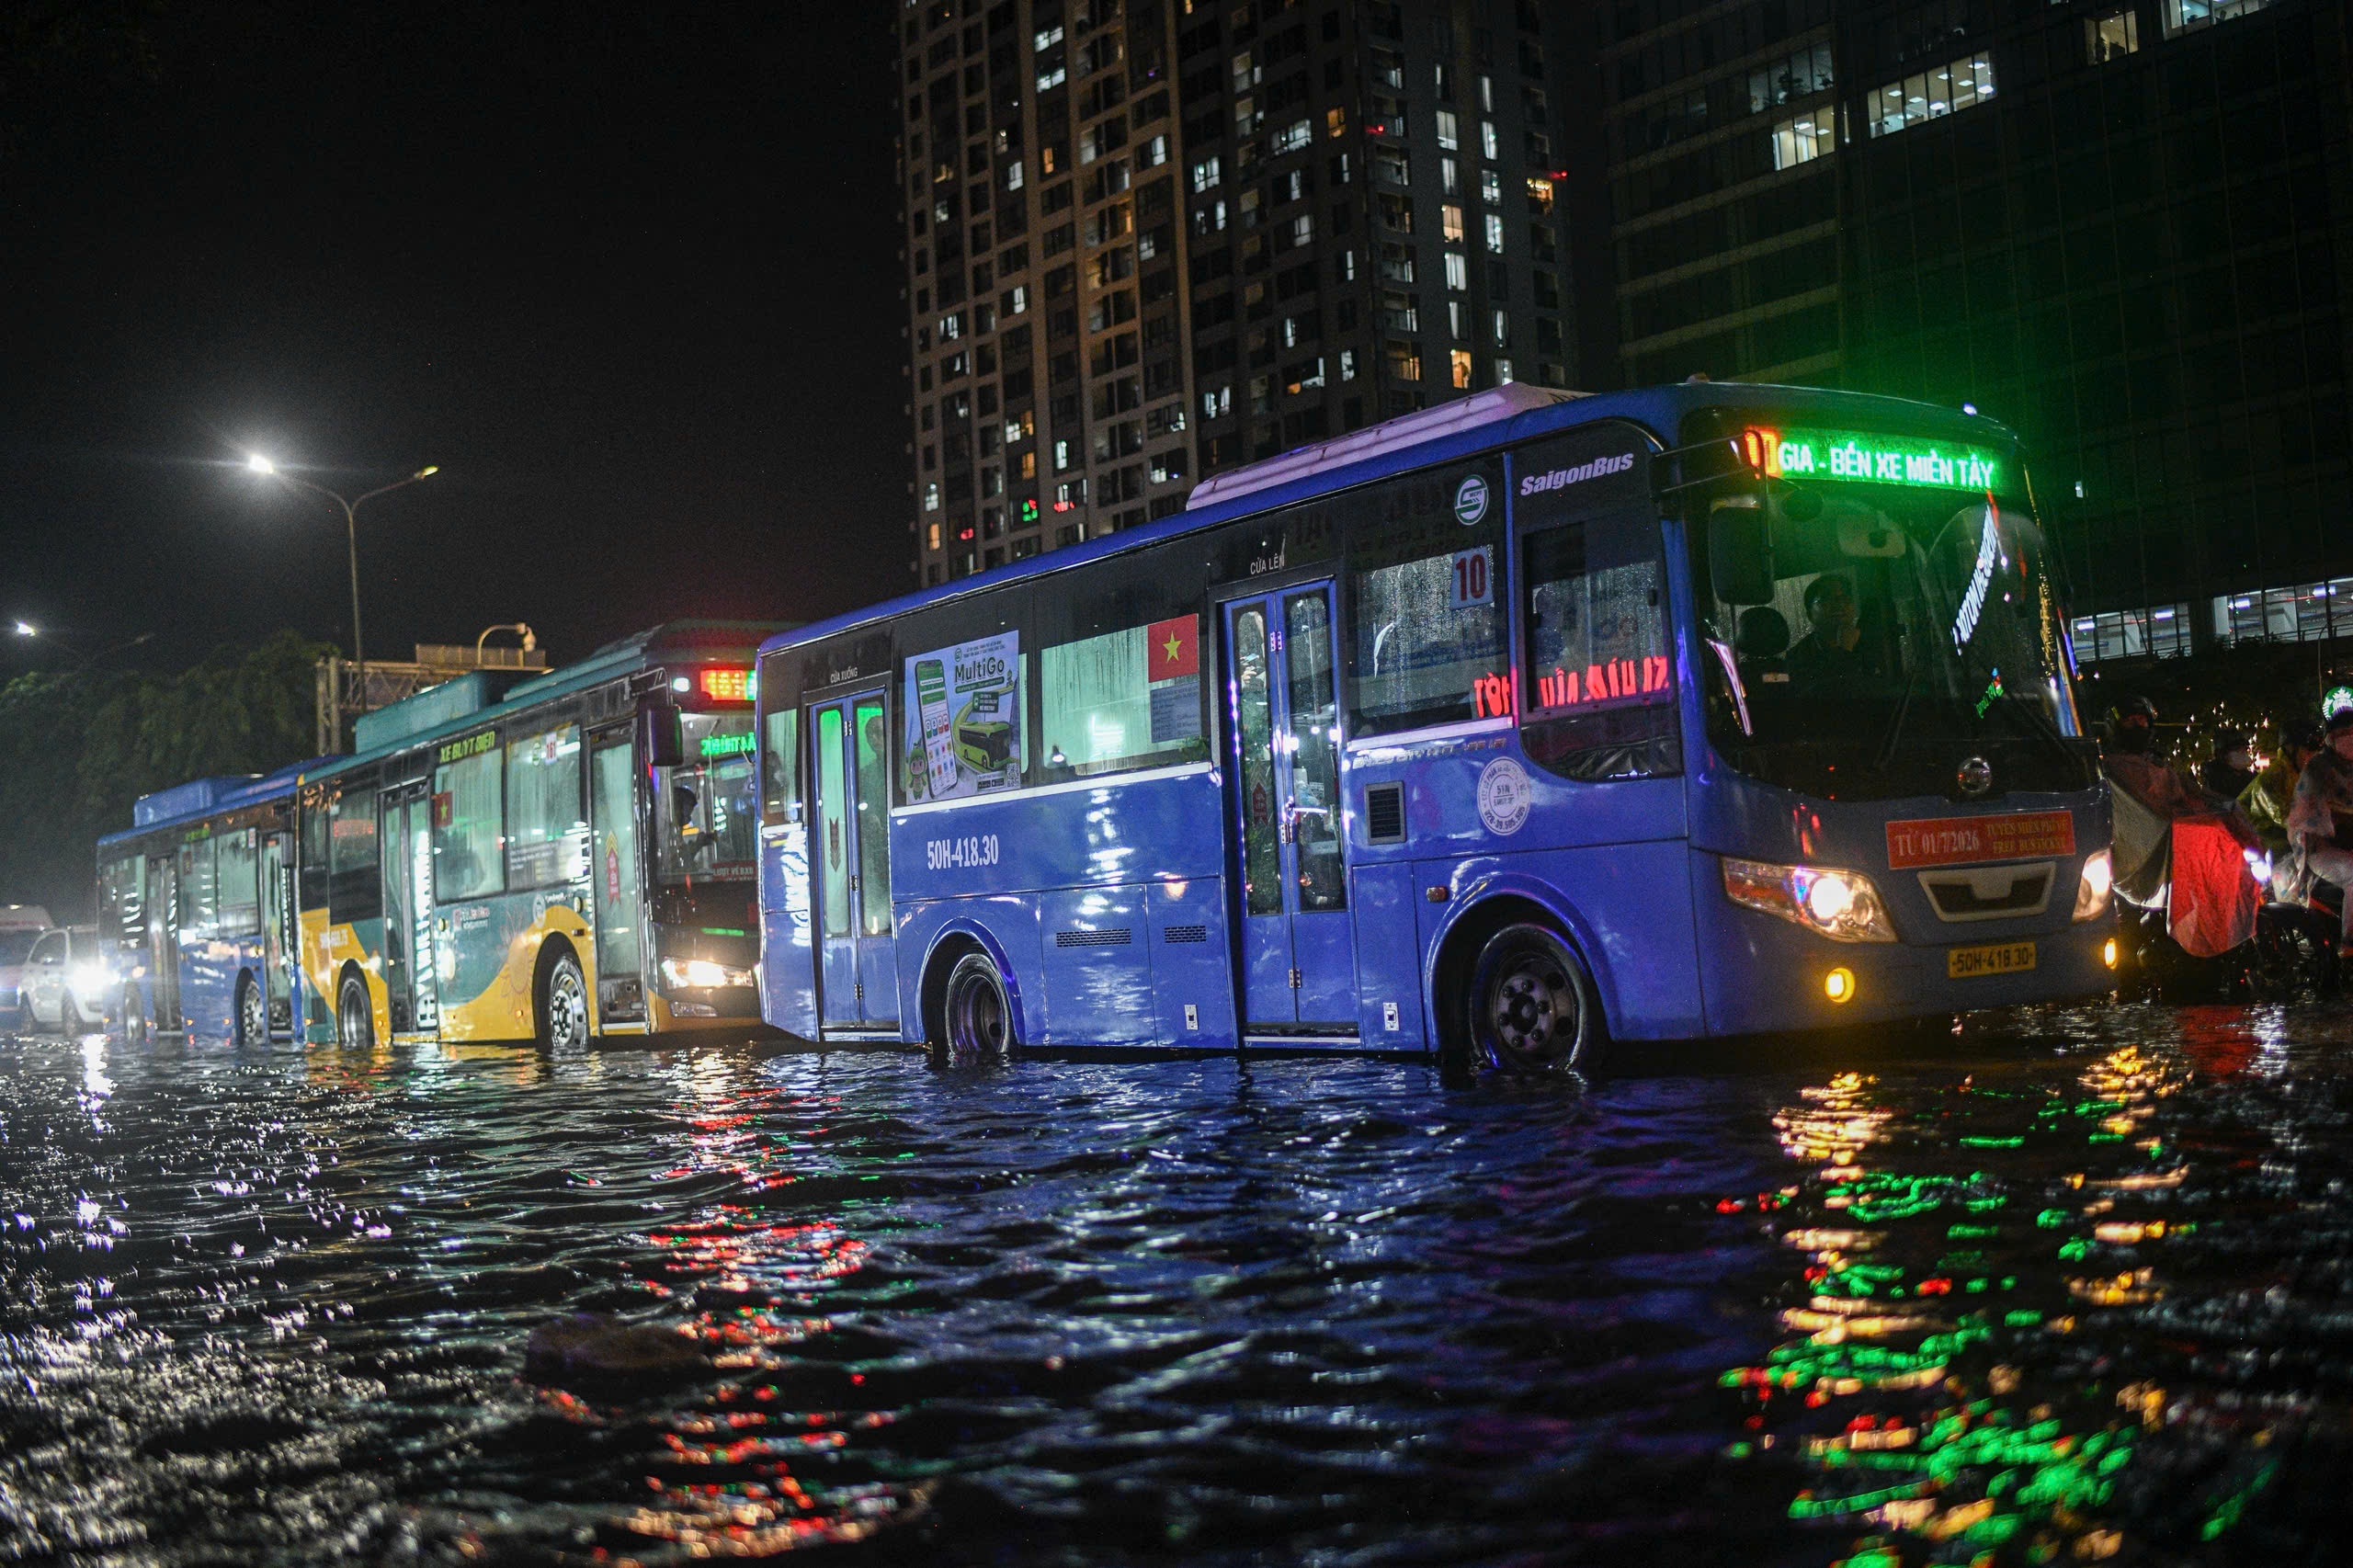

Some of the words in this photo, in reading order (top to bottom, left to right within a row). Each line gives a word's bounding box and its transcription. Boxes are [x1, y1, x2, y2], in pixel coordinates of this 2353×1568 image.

[1520, 453, 1634, 496] SaigonBus
[1779, 441, 1814, 473] GIA
[1830, 440, 1871, 478] BẾN
[1876, 450, 1903, 481] XE
[1906, 448, 1954, 485] MIỀN
[1957, 452, 1995, 489] TÂY
[1456, 554, 1486, 601] 10
[955, 657, 1005, 684] MultiGo
[927, 835, 998, 869] 50H-418.30
[1895, 828, 1918, 857] TỪ
[1922, 830, 1981, 855] 01/7/2026
[1956, 947, 2029, 971] 50H-418.30
